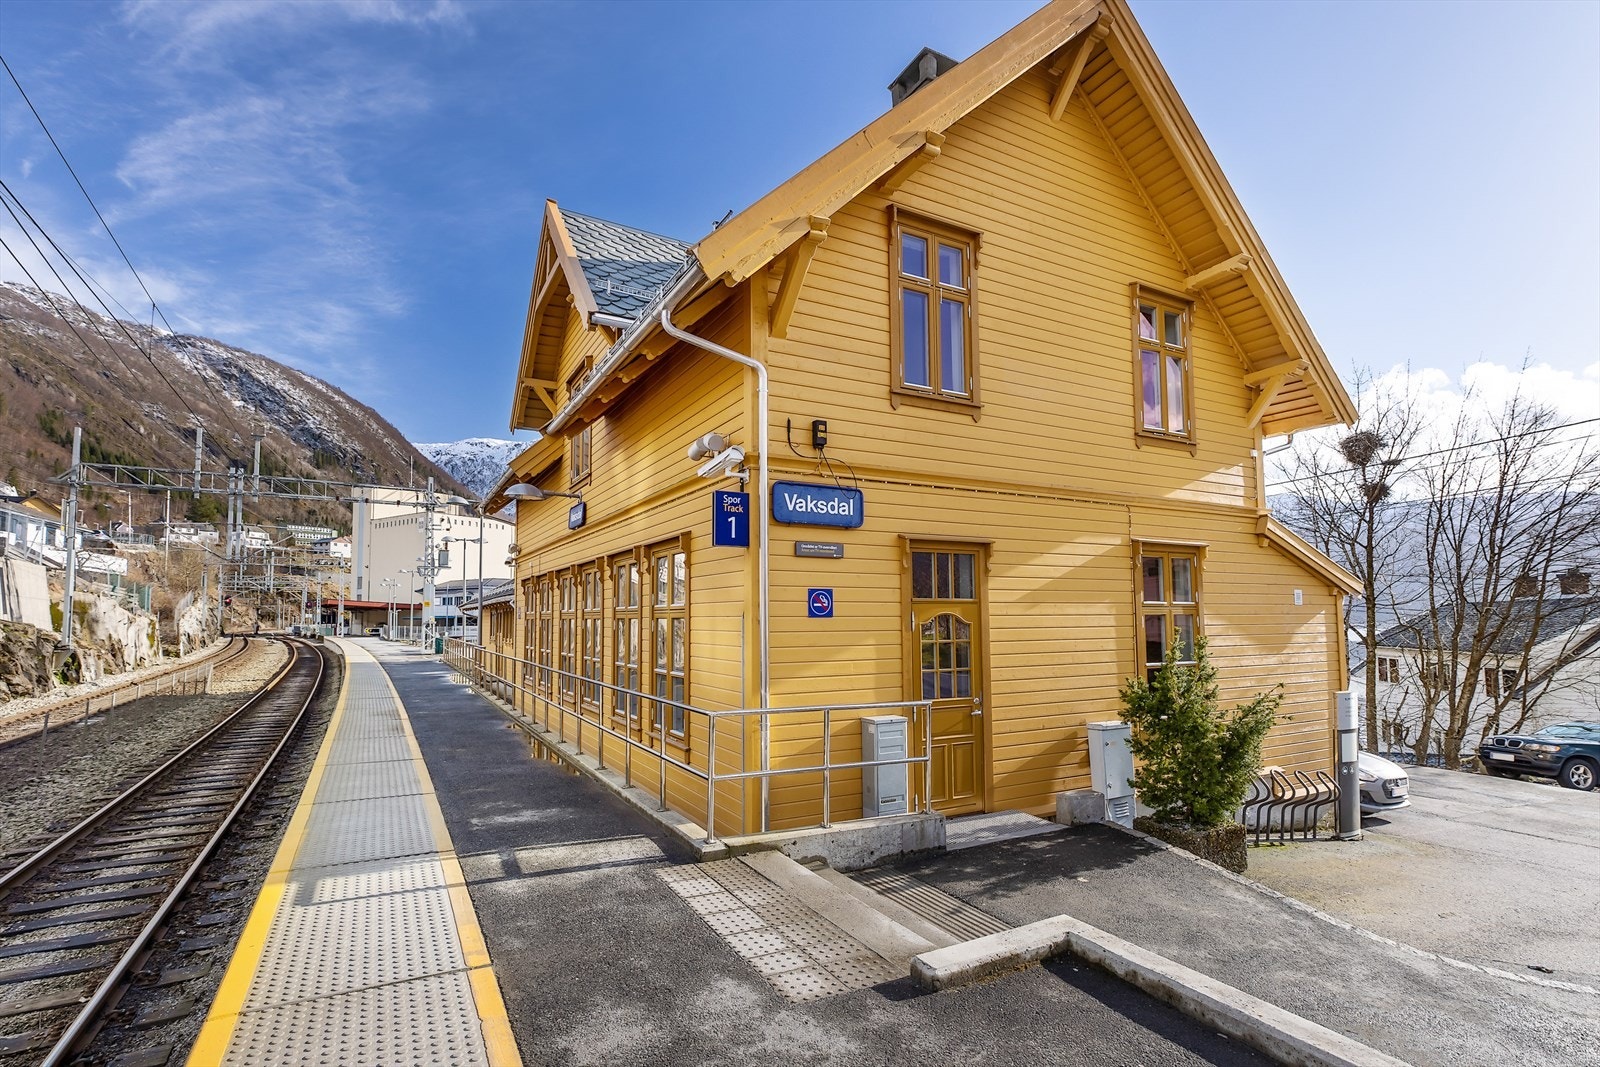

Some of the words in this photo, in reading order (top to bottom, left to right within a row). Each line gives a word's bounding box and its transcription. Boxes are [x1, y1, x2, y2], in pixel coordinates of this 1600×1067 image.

[723, 494, 741, 504] Spor
[784, 492, 854, 516] Vaksdal
[723, 503, 744, 513] Track
[727, 516, 736, 539] 1
